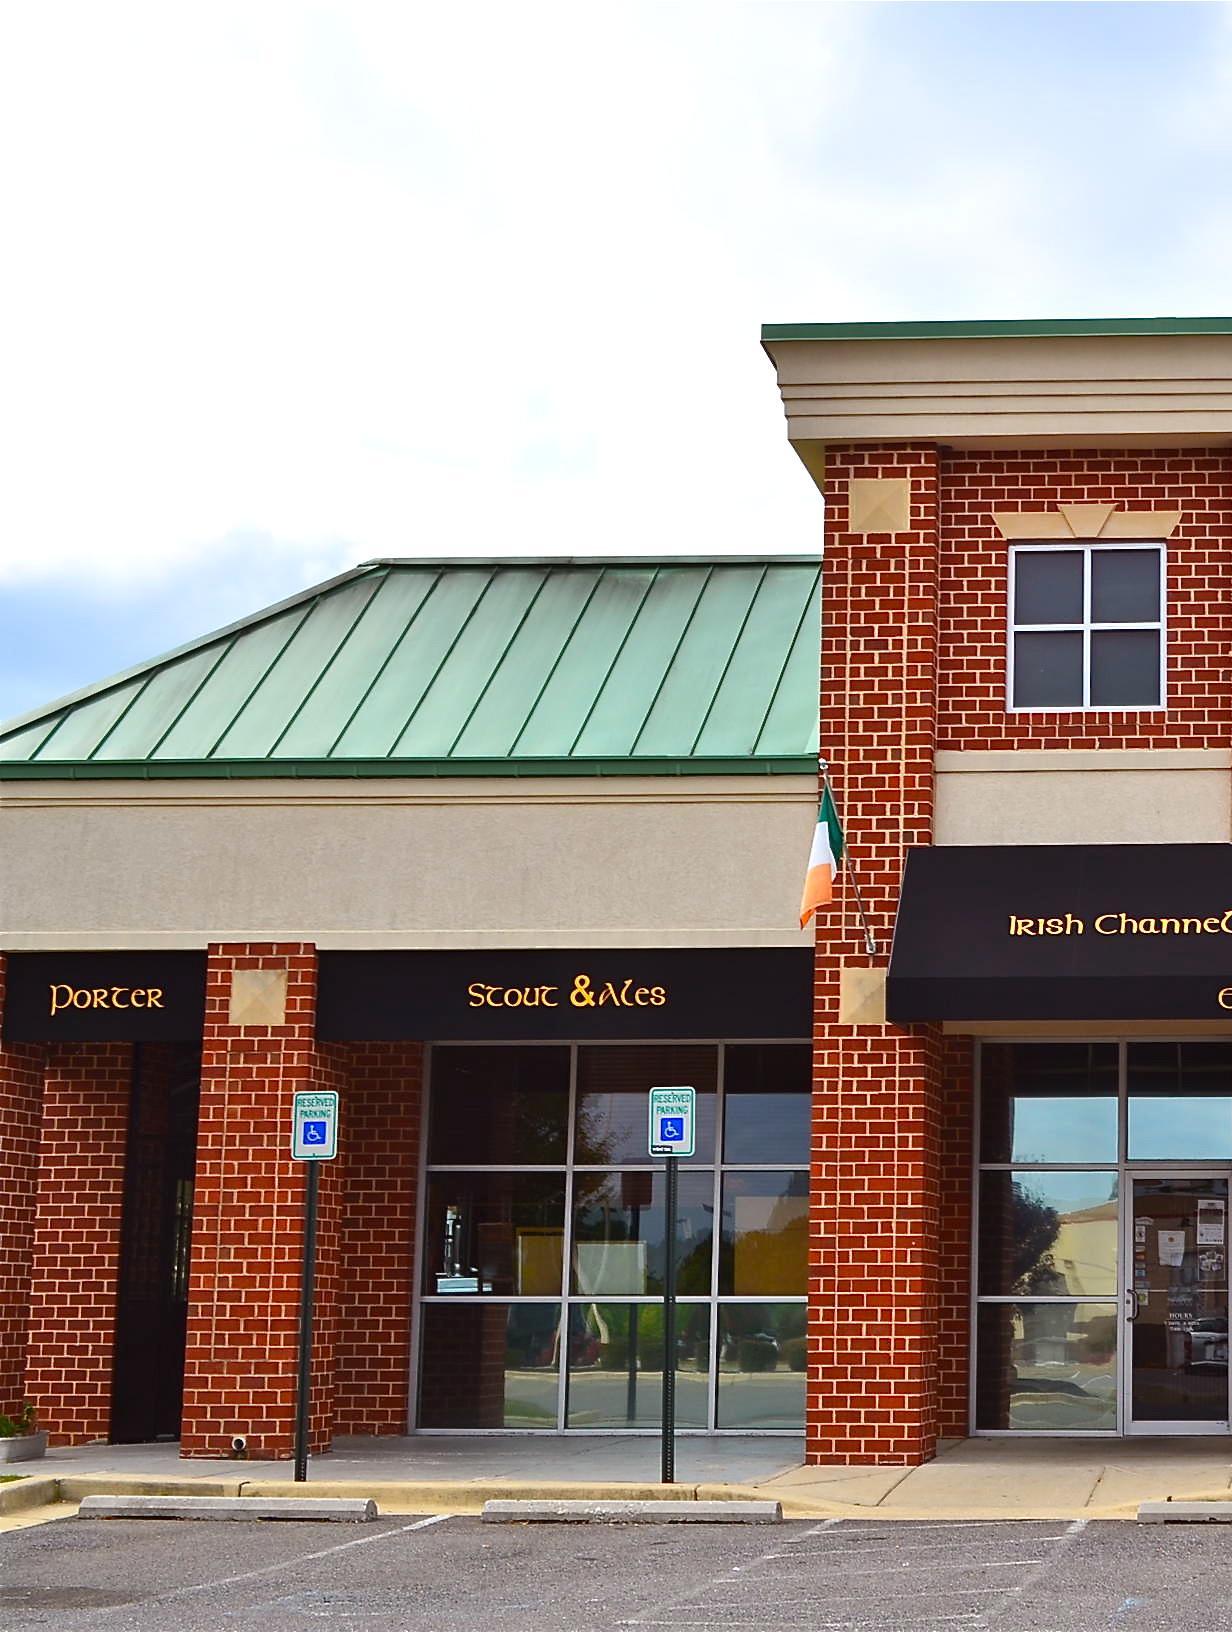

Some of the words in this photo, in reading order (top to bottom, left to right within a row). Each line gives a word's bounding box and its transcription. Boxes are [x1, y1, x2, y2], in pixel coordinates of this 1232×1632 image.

[1008, 913, 1084, 936] Irish
[468, 982, 559, 1007] Stout
[49, 984, 165, 1017] Porter
[296, 1098, 336, 1107] RESERVED
[652, 1094, 691, 1103] RESERVED
[300, 1109, 331, 1119] PARKING
[656, 1105, 689, 1115] PARKING
